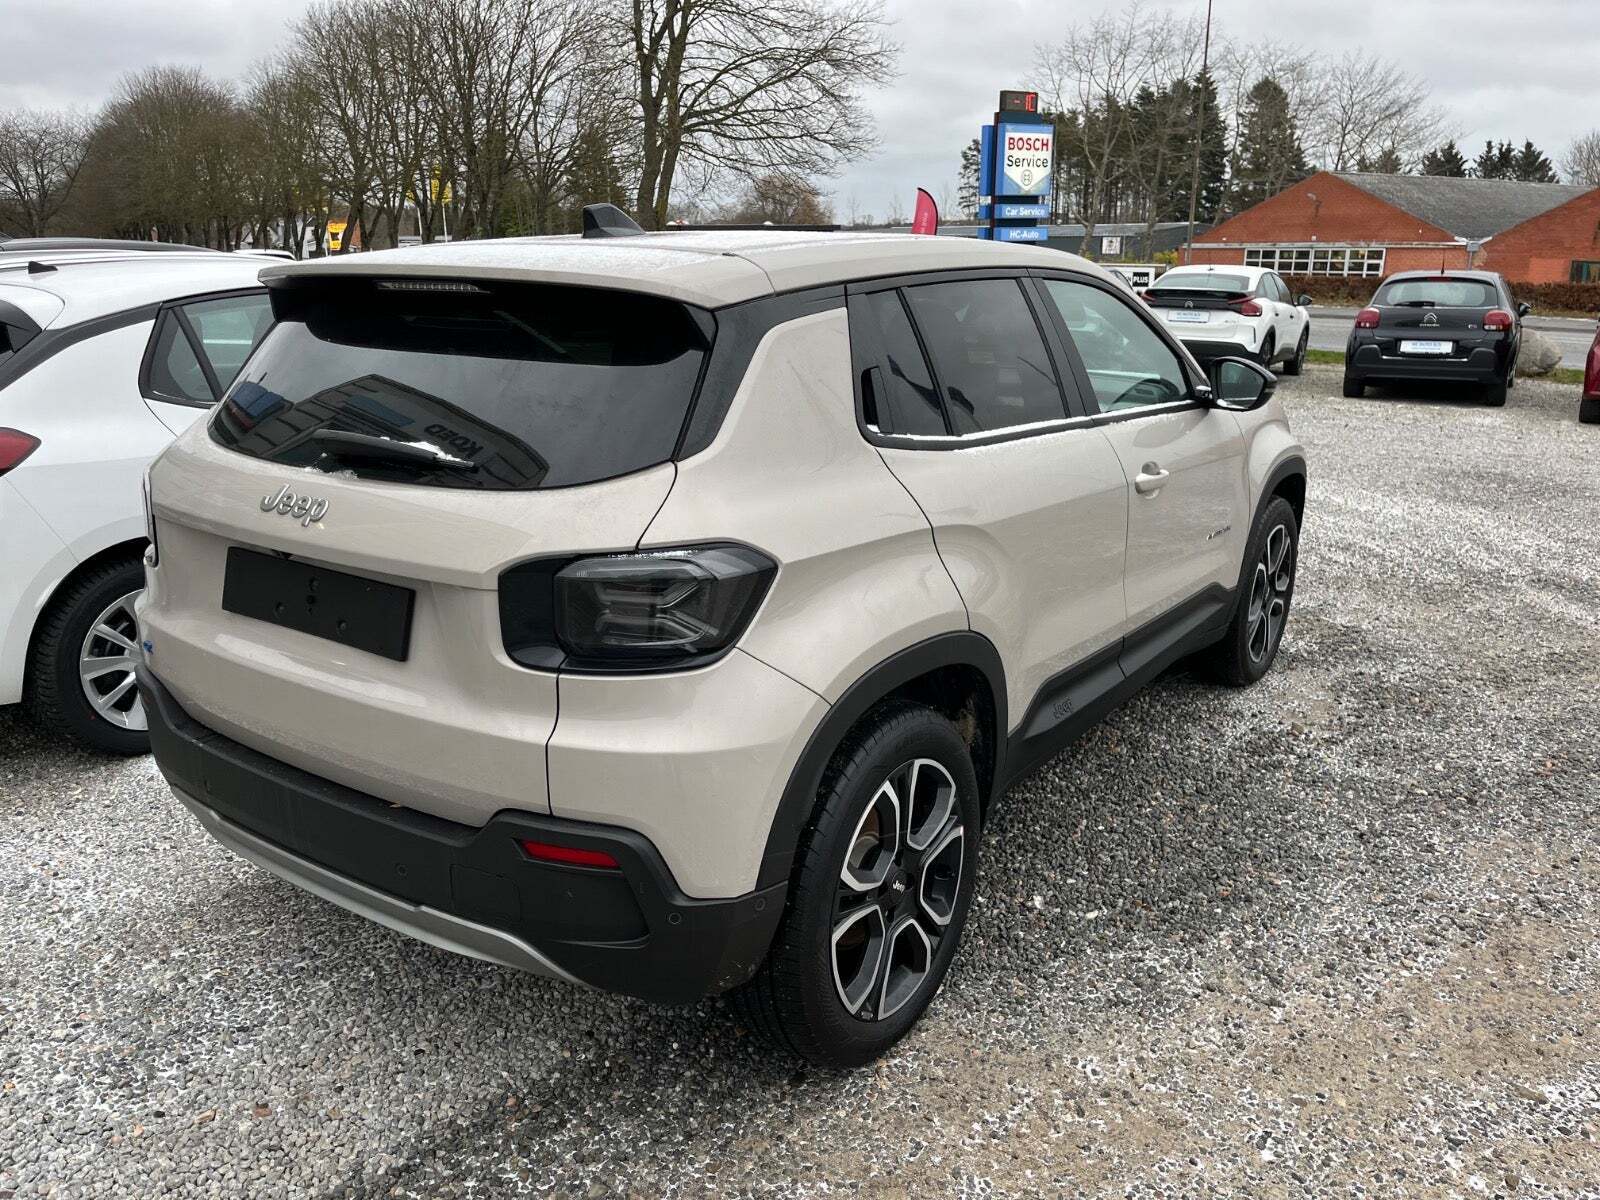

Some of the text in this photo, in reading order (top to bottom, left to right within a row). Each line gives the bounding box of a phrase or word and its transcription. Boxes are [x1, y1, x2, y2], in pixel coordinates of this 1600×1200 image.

[1007, 137, 1049, 151] BOSCH
[1006, 154, 1049, 168] Service
[1005, 207, 1045, 216] Car Service
[1009, 230, 1039, 239] HC-Auto
[1133, 275, 1148, 283] PLUS
[260, 483, 330, 527] Jeep
[892, 880, 906, 893] Jeep
